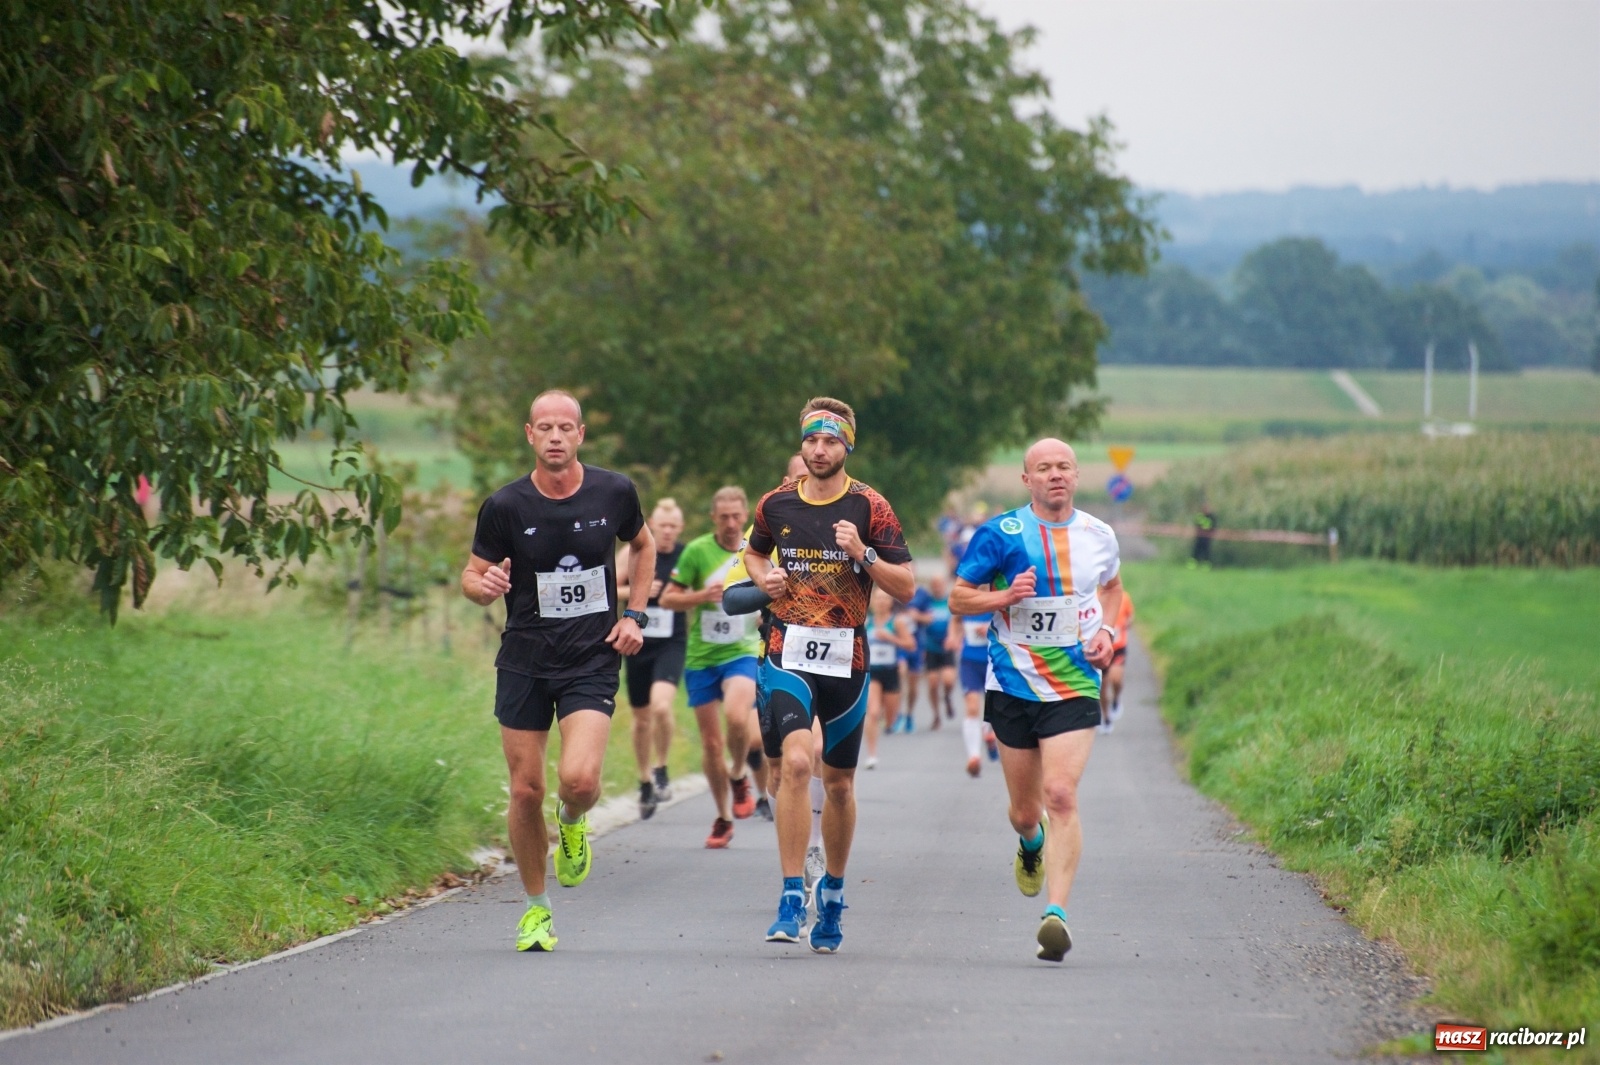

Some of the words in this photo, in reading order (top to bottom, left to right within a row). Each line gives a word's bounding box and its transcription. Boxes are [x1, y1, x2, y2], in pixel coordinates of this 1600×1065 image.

[524, 527, 537, 536] 4F
[781, 547, 849, 561] PIERUNSKIE
[787, 561, 843, 573] CANGÓRY
[560, 584, 586, 605] 59
[713, 621, 731, 635] 49
[1031, 612, 1057, 633] 37
[805, 640, 831, 661] 87
